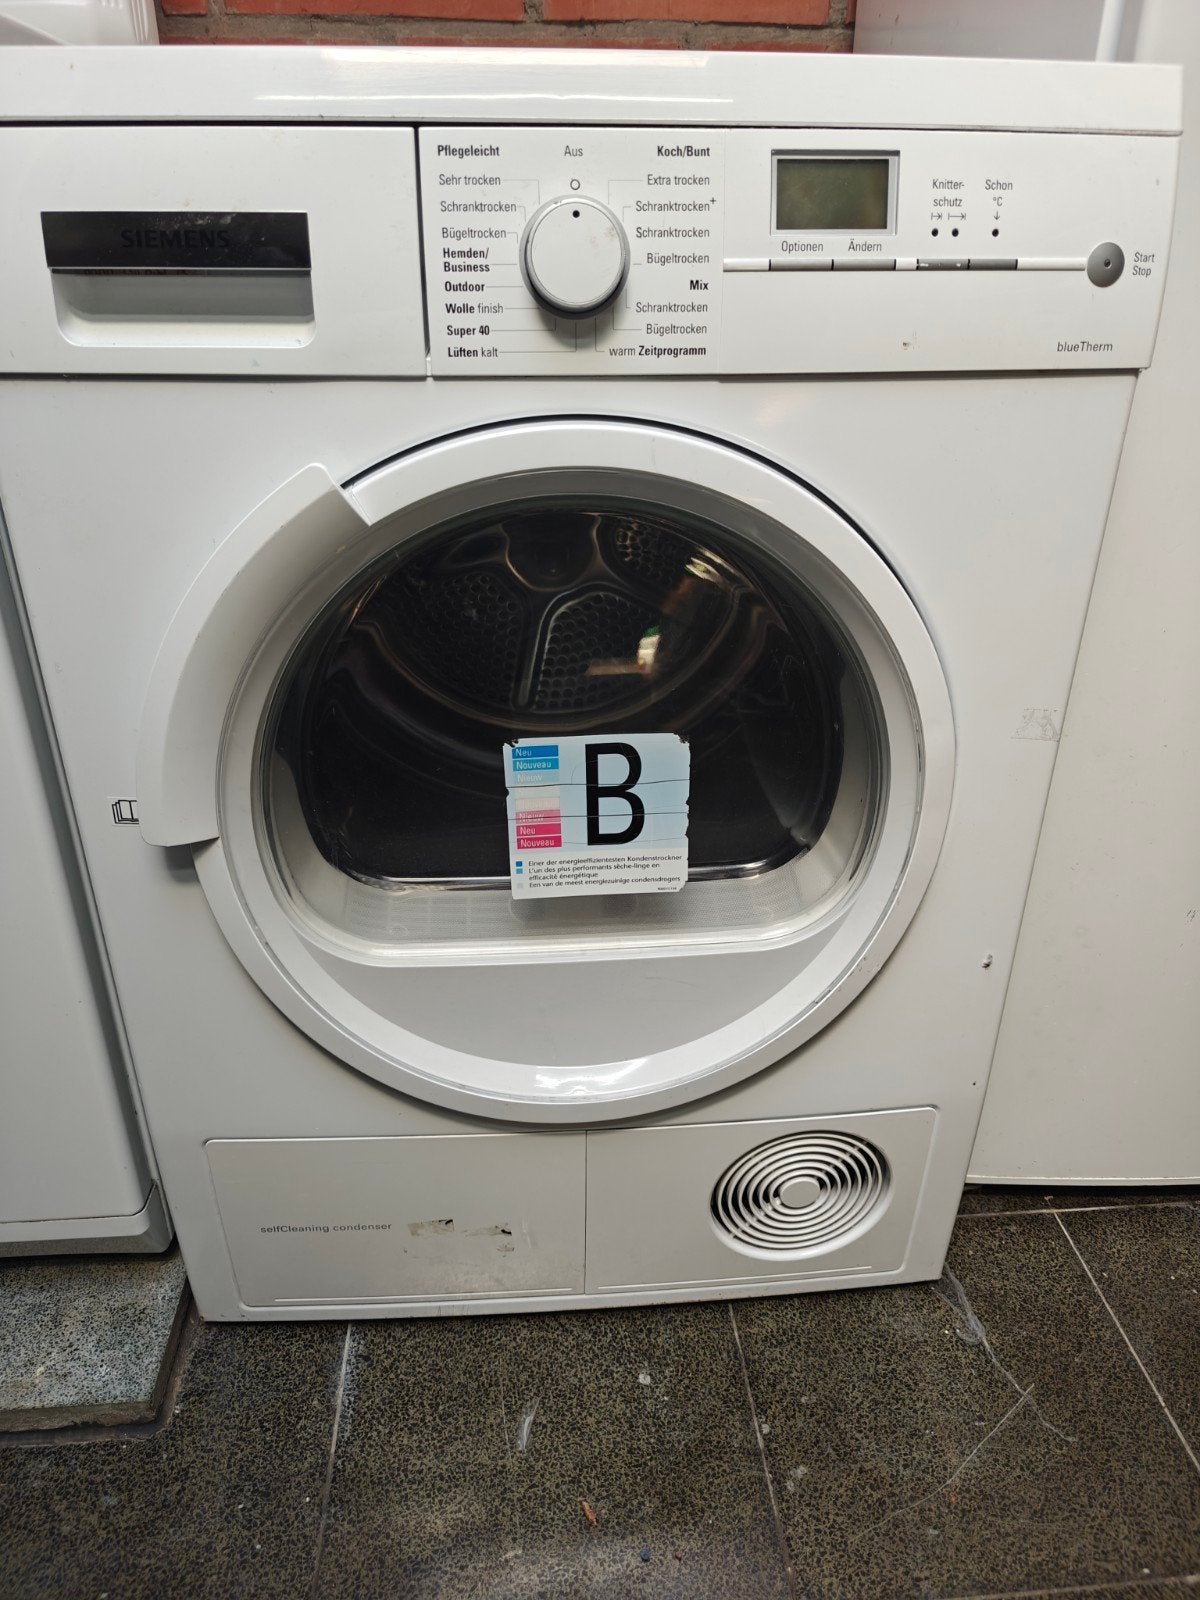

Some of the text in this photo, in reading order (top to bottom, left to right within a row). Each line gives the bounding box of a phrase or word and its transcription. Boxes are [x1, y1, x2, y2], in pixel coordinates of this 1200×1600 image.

[437, 145, 500, 158] Pflegeleicht
[564, 145, 584, 157] Aus
[657, 145, 711, 157] Koch/Bunt
[439, 174, 501, 186] Sehr trocken
[647, 174, 710, 186] Extra trocken
[932, 179, 965, 191] Knitter-
[985, 179, 1013, 191] Schon
[440, 201, 517, 213] Schranktrocken
[933, 196, 963, 208] schutz
[992, 196, 1003, 207] °C
[120, 229, 230, 249] SIEMENS
[442, 227, 507, 241] Bügeltrocken
[635, 227, 710, 239] Schranktrocken
[781, 240, 824, 254] Optionen
[848, 238, 882, 252] Ändern
[443, 247, 489, 260] Hemden/
[646, 252, 710, 266] Bügeltrocken
[1133, 252, 1155, 263] Start
[443, 261, 490, 273] Business
[1132, 265, 1152, 277] Stop
[444, 281, 485, 293] Outdoor
[689, 279, 709, 291] Mix
[445, 303, 504, 314] Wolle finish
[635, 302, 708, 314] Schranktrocken
[447, 325, 490, 338] Super 40
[646, 323, 707, 337] Bügeltrocken
[447, 345, 499, 358] Lüften kalt
[609, 345, 707, 358] warm Zeitprogramm
[1056, 341, 1113, 353] blueTherm
[515, 748, 532, 757] Neu
[516, 761, 552, 770] Nouveau
[585, 742, 645, 845] B
[519, 826, 536, 835] Neu
[520, 838, 554, 848] Nouveau
[627, 854, 682, 862] Kondenstrockner
[557, 866, 571, 874] plus
[260, 1222, 392, 1234] selfCleaning condenser
